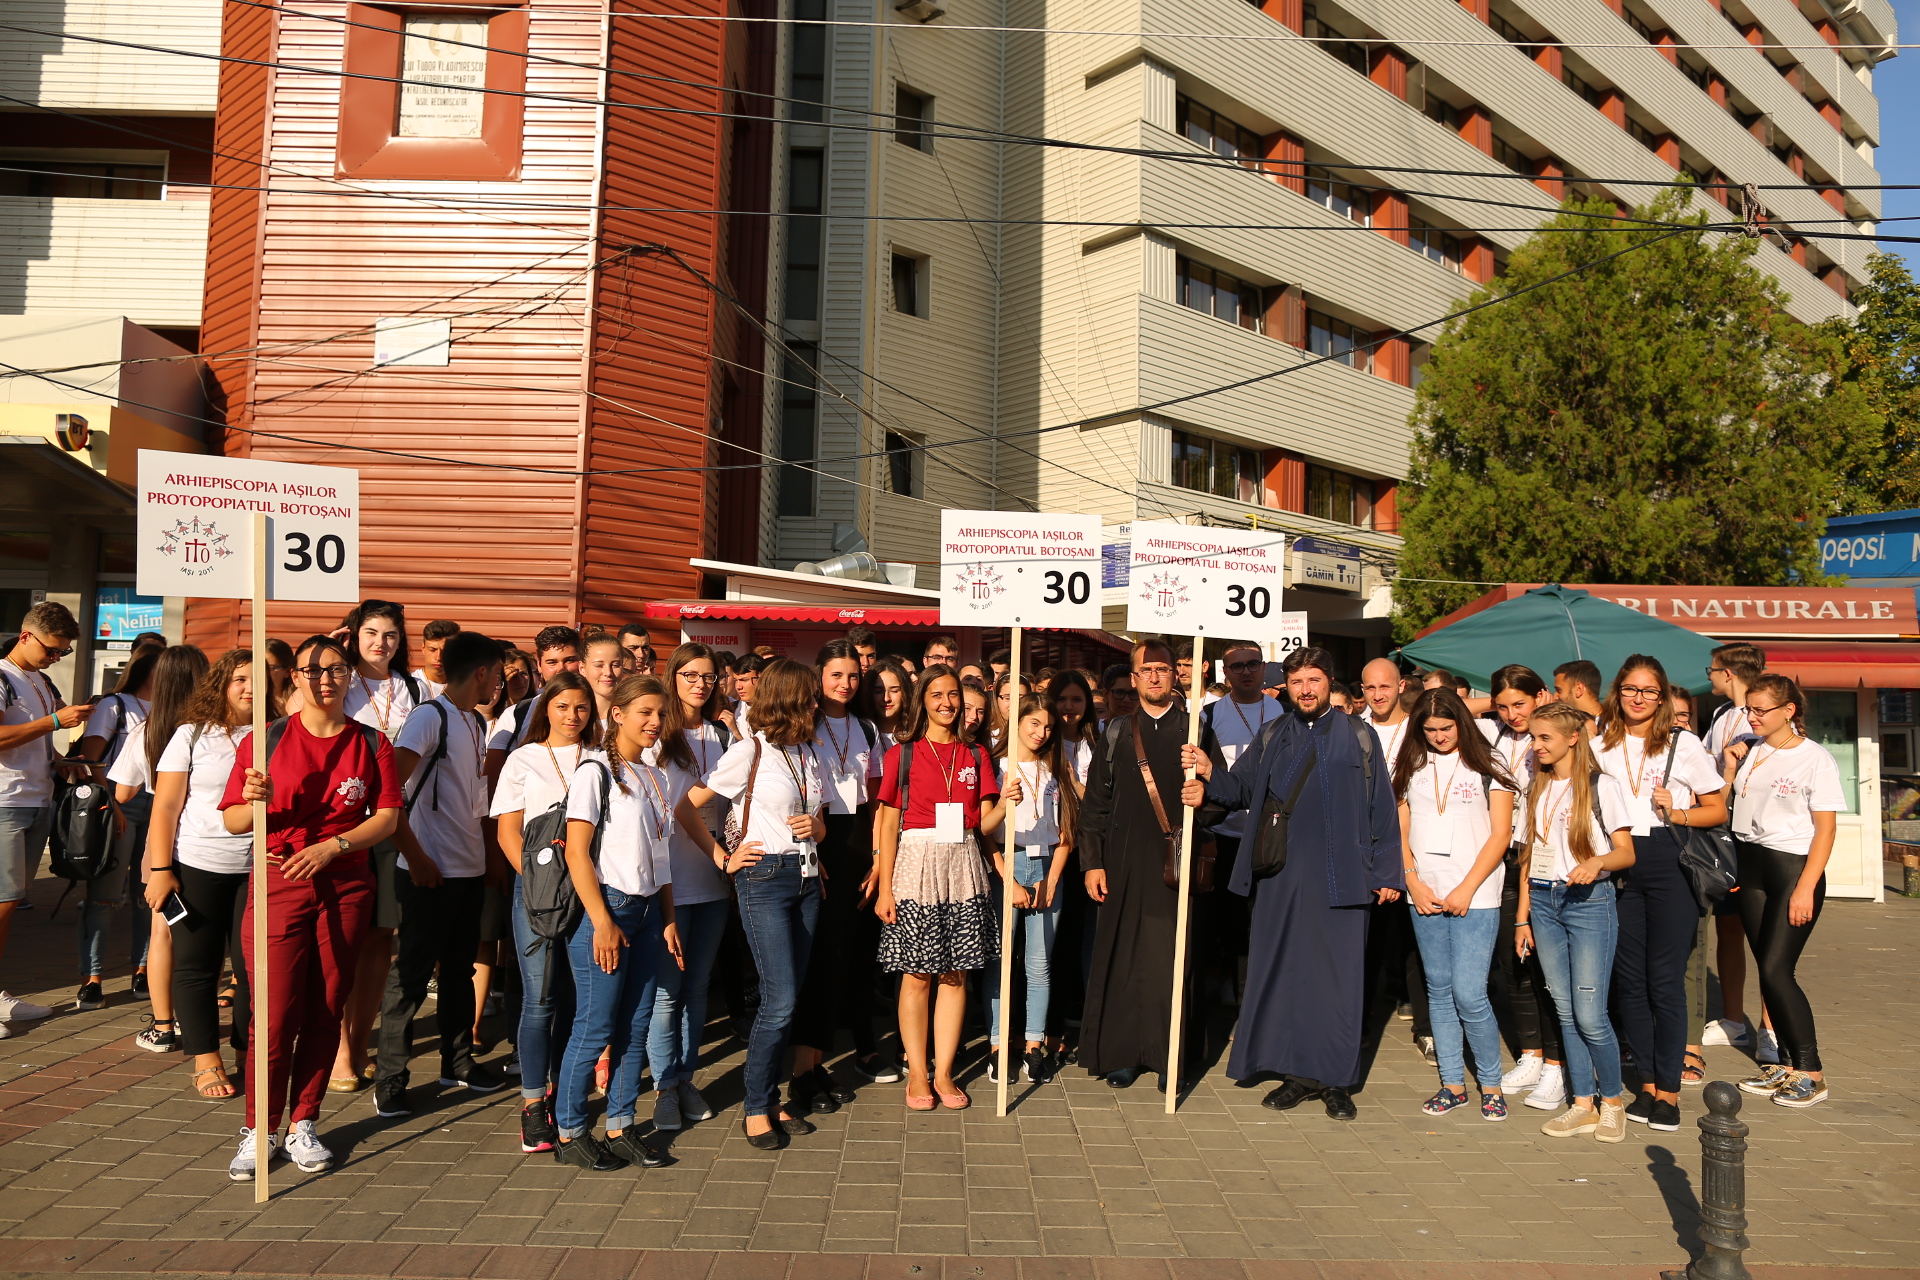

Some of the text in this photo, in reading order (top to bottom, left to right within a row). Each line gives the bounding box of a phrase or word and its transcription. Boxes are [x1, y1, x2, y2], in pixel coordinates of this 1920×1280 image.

[71, 422, 84, 435] BT
[165, 473, 337, 499] ARHIEPISCOPIA IAȘILOR
[147, 492, 351, 519] PROTOPOPIATUL BOTOȘANI
[958, 528, 1083, 542] ARHIEPISCOPIA IAȘILOR
[1119, 525, 1132, 534] Re
[284, 532, 346, 574] 30
[946, 543, 1095, 558] PROTOPOPIATUL BOTOȘANI
[1147, 538, 1266, 558] ARHIEPISCOPIA IAȘILOR
[1821, 530, 1885, 568] pepsi
[198, 565, 214, 576] 2017
[1134, 553, 1277, 574] PROTOPOPIATUL BOTOȘANI
[1306, 565, 1334, 581] CĂMIN
[1043, 570, 1091, 605] 30
[1225, 584, 1271, 618] 30
[1671, 598, 1895, 620] NATURALE
[690, 635, 739, 646] MENIU CREPA
[1281, 637, 1302, 652] 29
